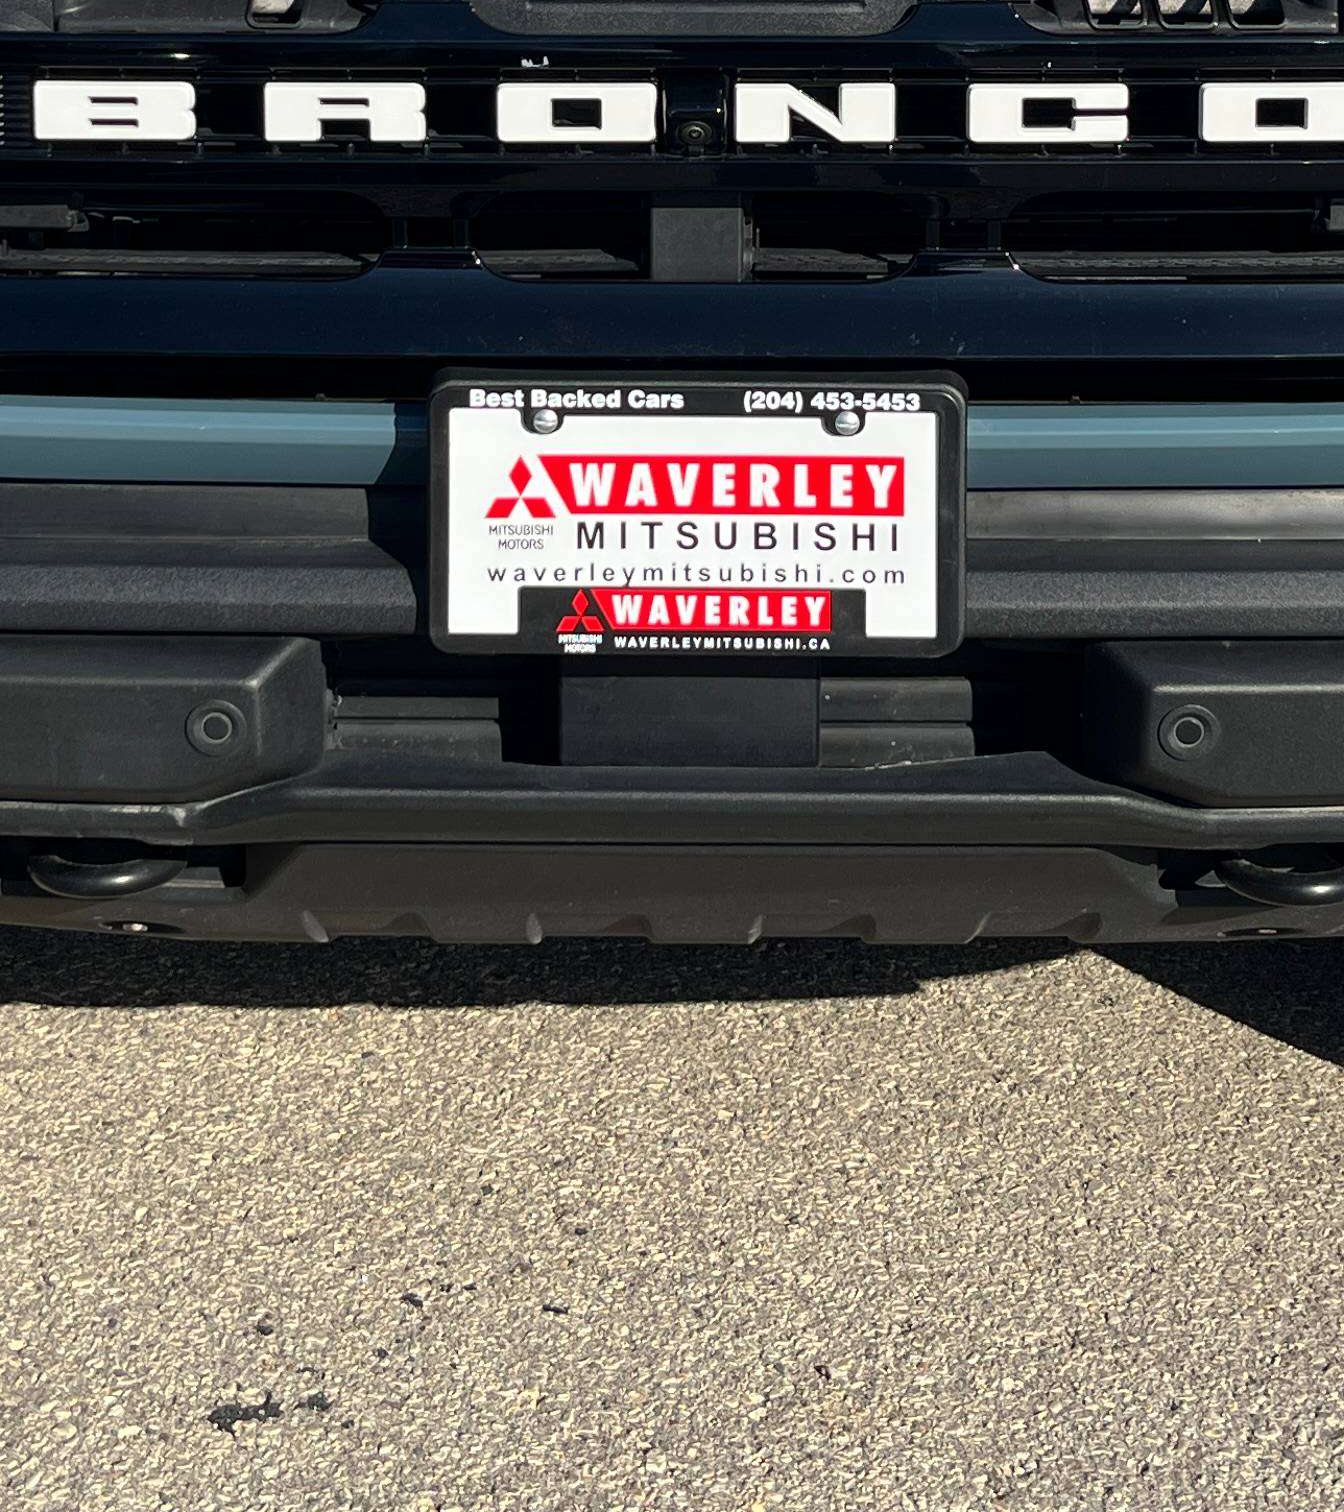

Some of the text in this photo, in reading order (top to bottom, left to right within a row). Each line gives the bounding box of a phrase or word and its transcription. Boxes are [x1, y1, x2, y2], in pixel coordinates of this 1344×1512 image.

[469, 388, 685, 409] Best Backed Cars
[743, 390, 920, 414] (204) 453-5453
[568, 462, 897, 509] WAVERLEY
[488, 525, 554, 535] MITSUBISHI
[577, 521, 897, 552] MITSUBISHI
[498, 539, 544, 550] MOTORS
[487, 562, 905, 587] waverleymitsubishi.com
[611, 594, 826, 626] WAVERLEY
[614, 636, 831, 650] WAVERLEYMITSUBISHI.CA
